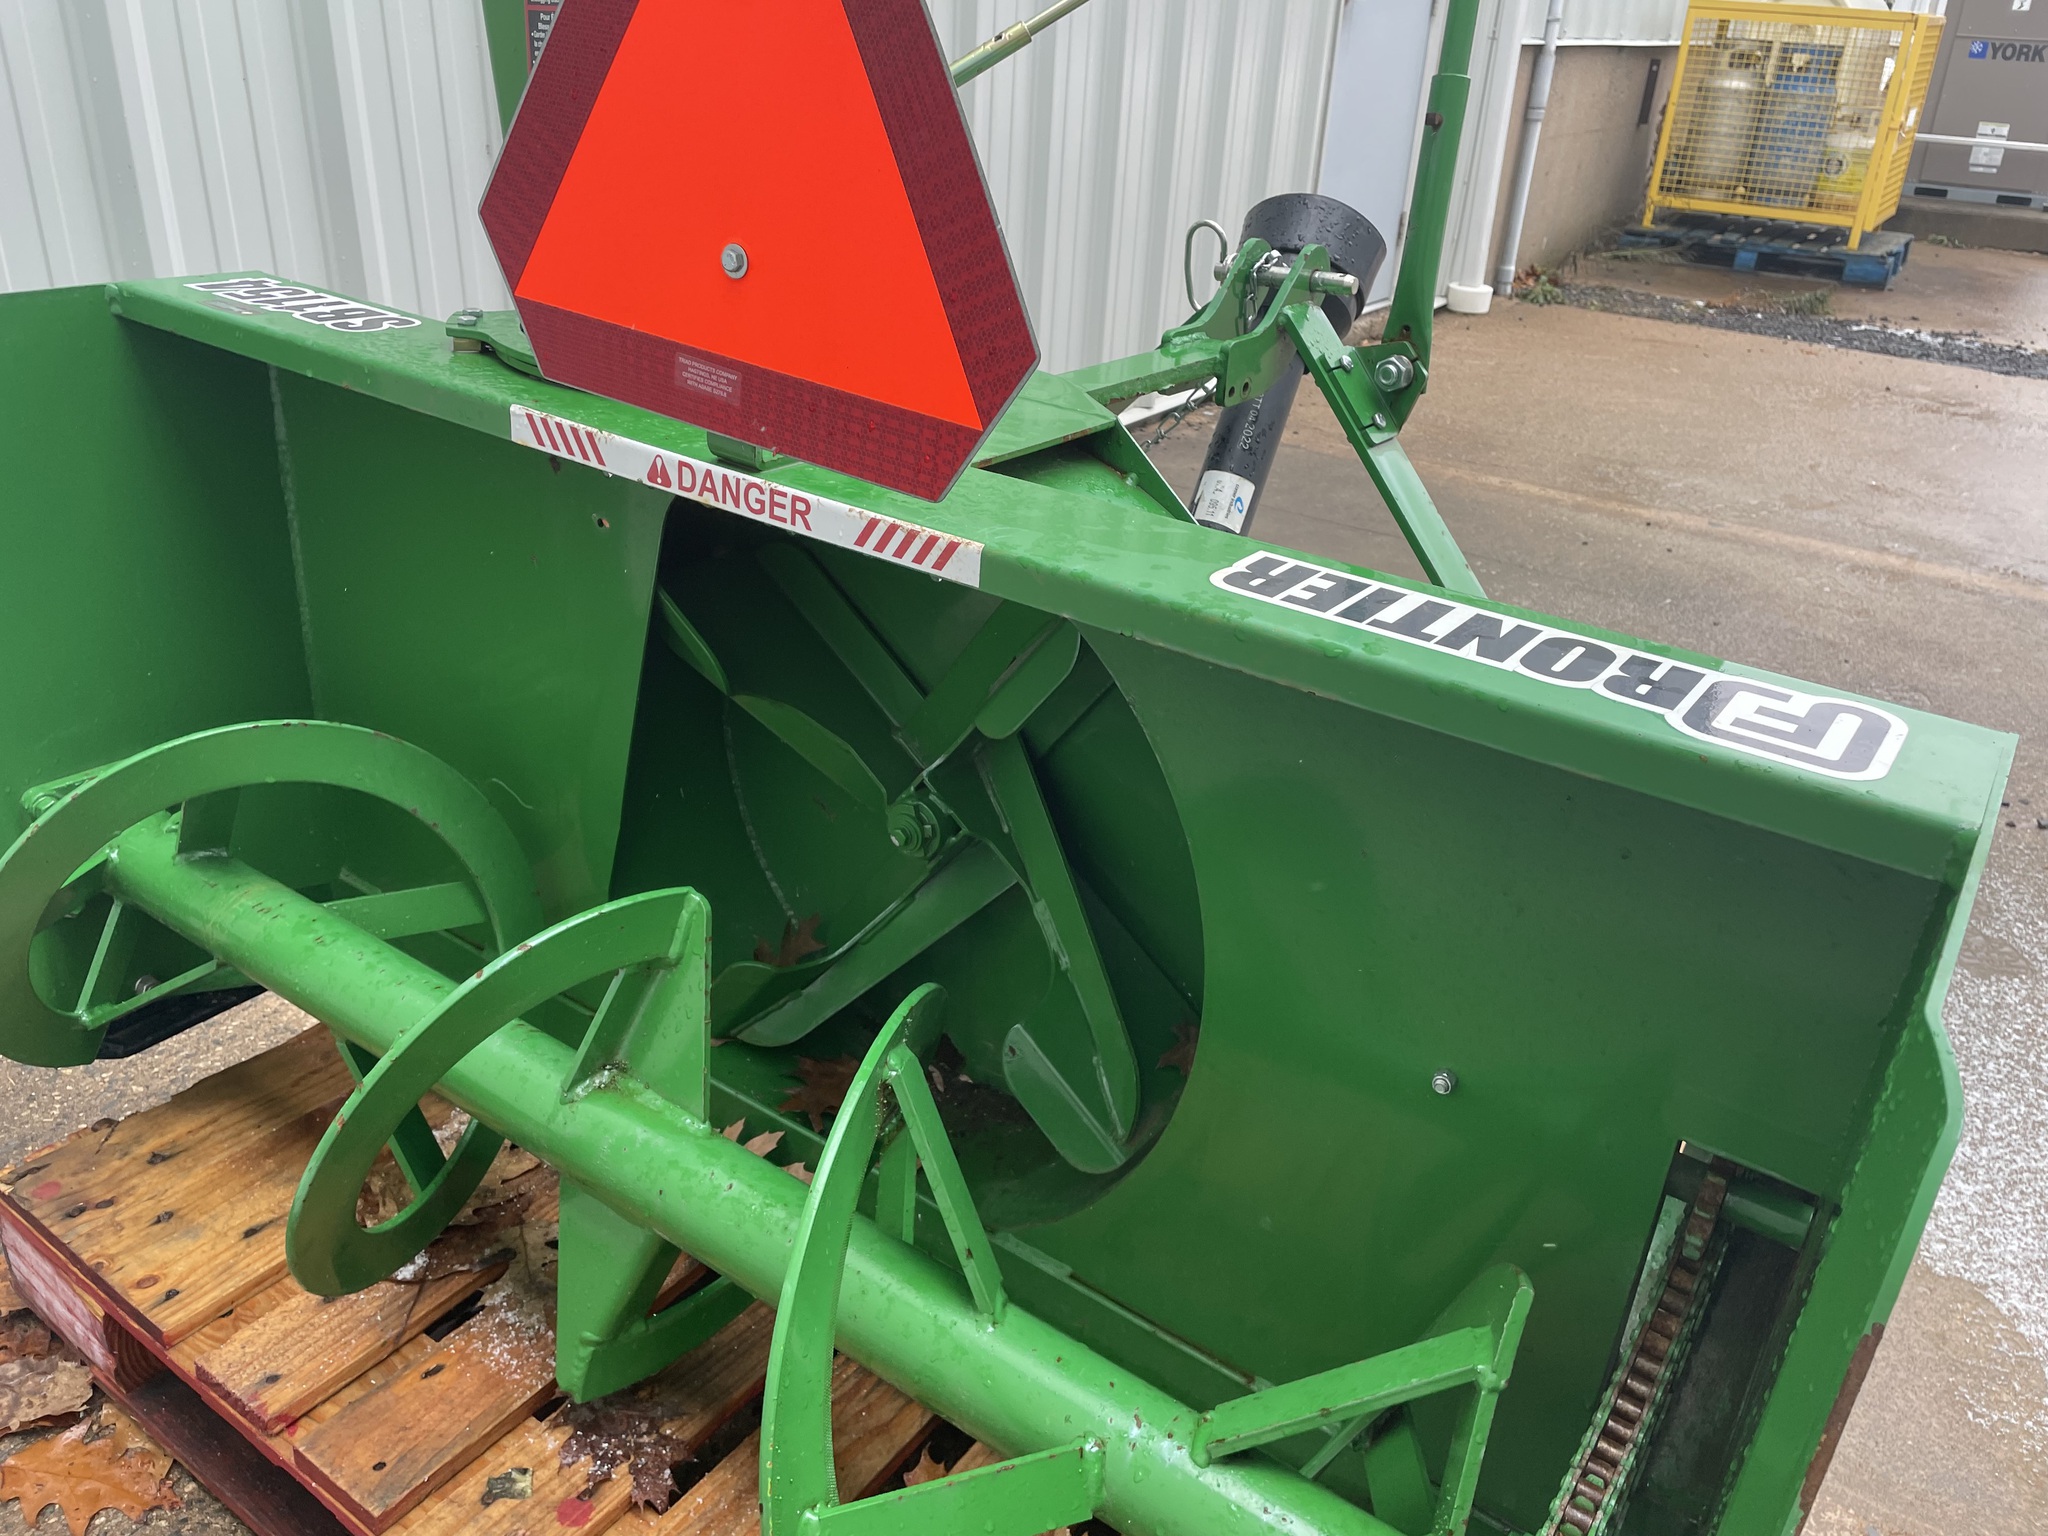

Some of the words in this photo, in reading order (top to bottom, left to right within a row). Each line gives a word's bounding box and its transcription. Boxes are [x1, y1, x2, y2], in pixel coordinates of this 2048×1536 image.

[1991, 41, 2048, 63] YORK
[692, 361, 716, 374] PRODUCTS
[715, 369, 738, 381] COMPANY
[704, 379, 732, 393] COMPLIANCE
[1239, 422, 1256, 450] 2022
[677, 460, 813, 532] DANGER
[1222, 556, 1895, 775] FRONTIER
